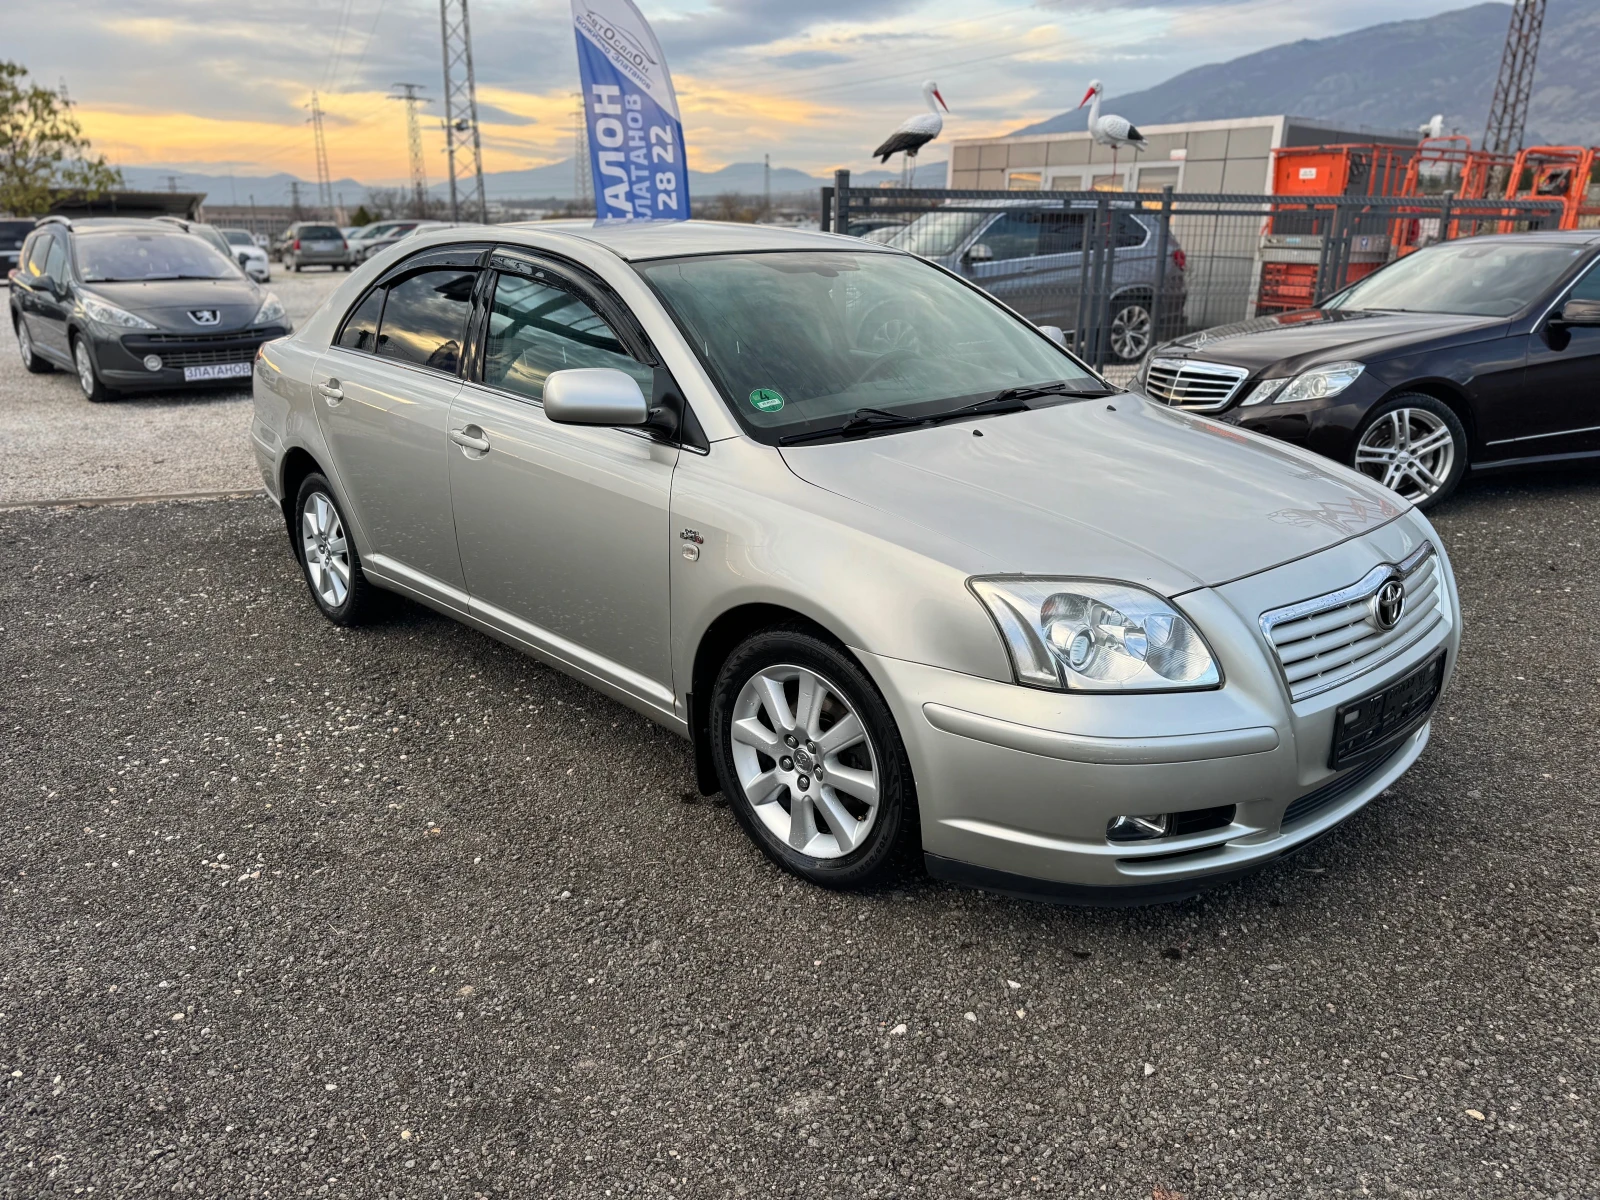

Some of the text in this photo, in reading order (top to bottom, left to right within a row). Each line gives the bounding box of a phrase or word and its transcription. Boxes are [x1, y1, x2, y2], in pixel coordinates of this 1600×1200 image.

[592, 84, 633, 220] АЛОН
[650, 125, 678, 211] 28 22
[186, 364, 251, 378] ЗЛАТАНОВ
[759, 390, 770, 400] 4
